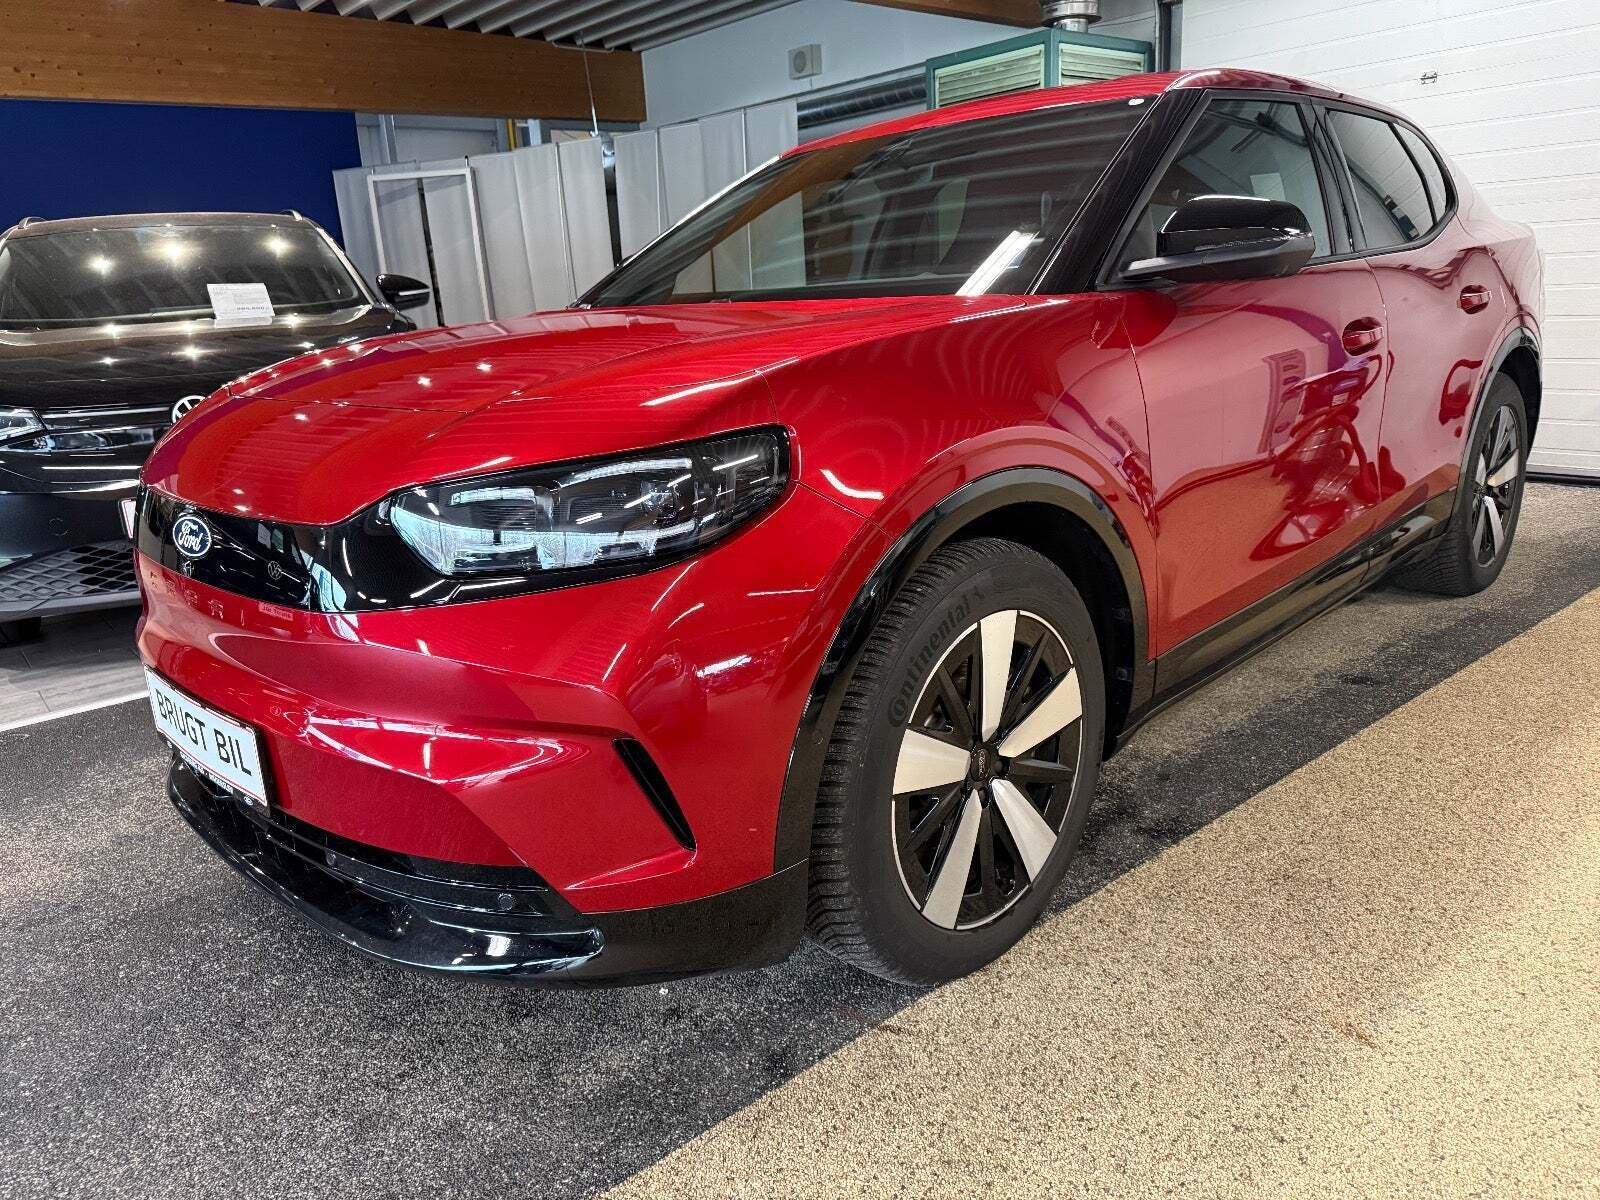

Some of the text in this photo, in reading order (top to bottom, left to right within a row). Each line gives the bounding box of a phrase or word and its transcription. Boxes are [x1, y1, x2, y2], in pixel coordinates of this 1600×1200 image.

[178, 520, 203, 552] Ford
[887, 593, 972, 727] Continental
[155, 687, 207, 751] BRUGT
[214, 728, 252, 776] BIL
